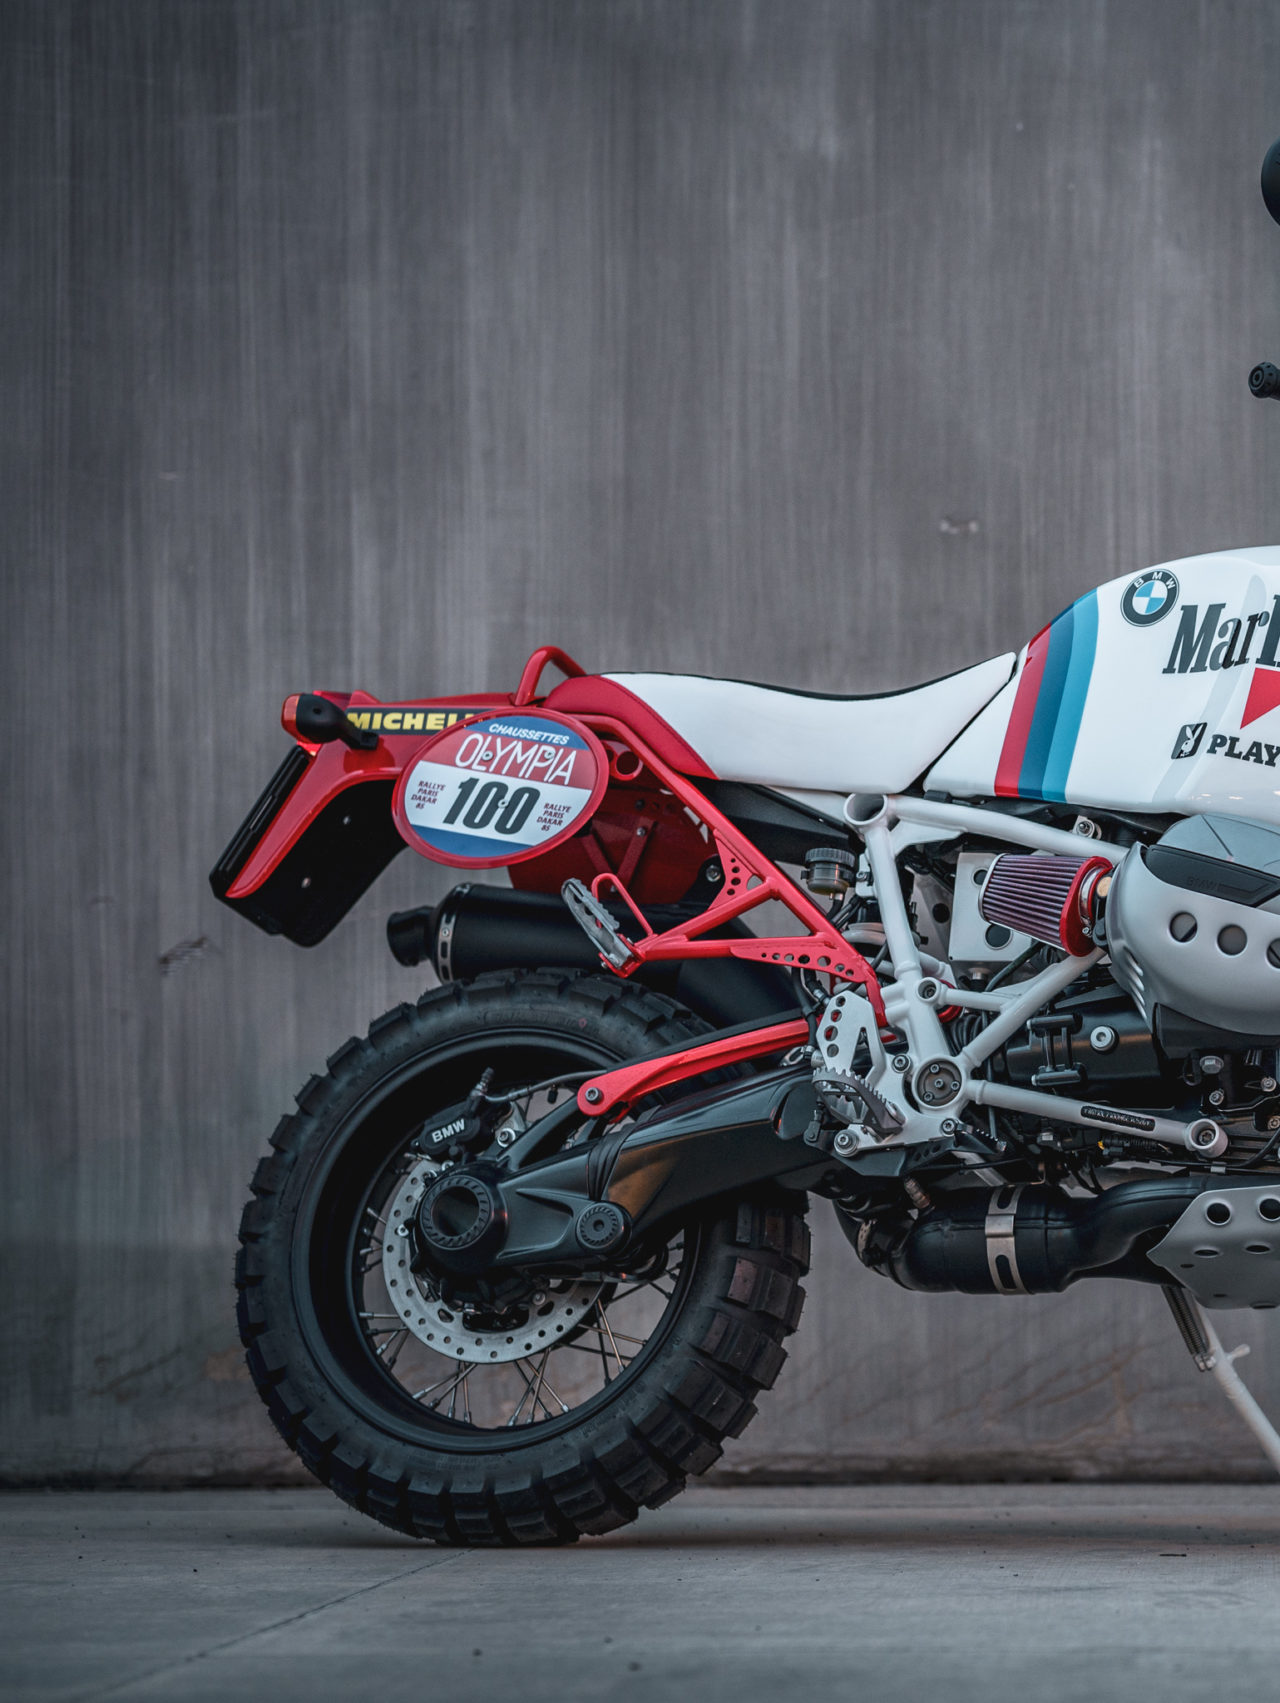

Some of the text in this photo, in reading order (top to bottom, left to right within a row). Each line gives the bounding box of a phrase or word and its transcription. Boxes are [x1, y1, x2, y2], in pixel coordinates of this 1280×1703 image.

[1132, 571, 1176, 590] BMW
[347, 712, 470, 730] MICHEL
[489, 723, 570, 745] CHAUSSETTES
[455, 733, 577, 785] OLYMPIA
[417, 788, 439, 797] PARIS
[418, 780, 446, 791] RALLYE
[411, 794, 437, 805] DAKAR
[442, 777, 541, 835] 100
[543, 810, 564, 819] PARIS
[544, 802, 572, 813] RALLYE
[536, 816, 563, 826] DAKAR
[431, 1118, 466, 1144] BMW
